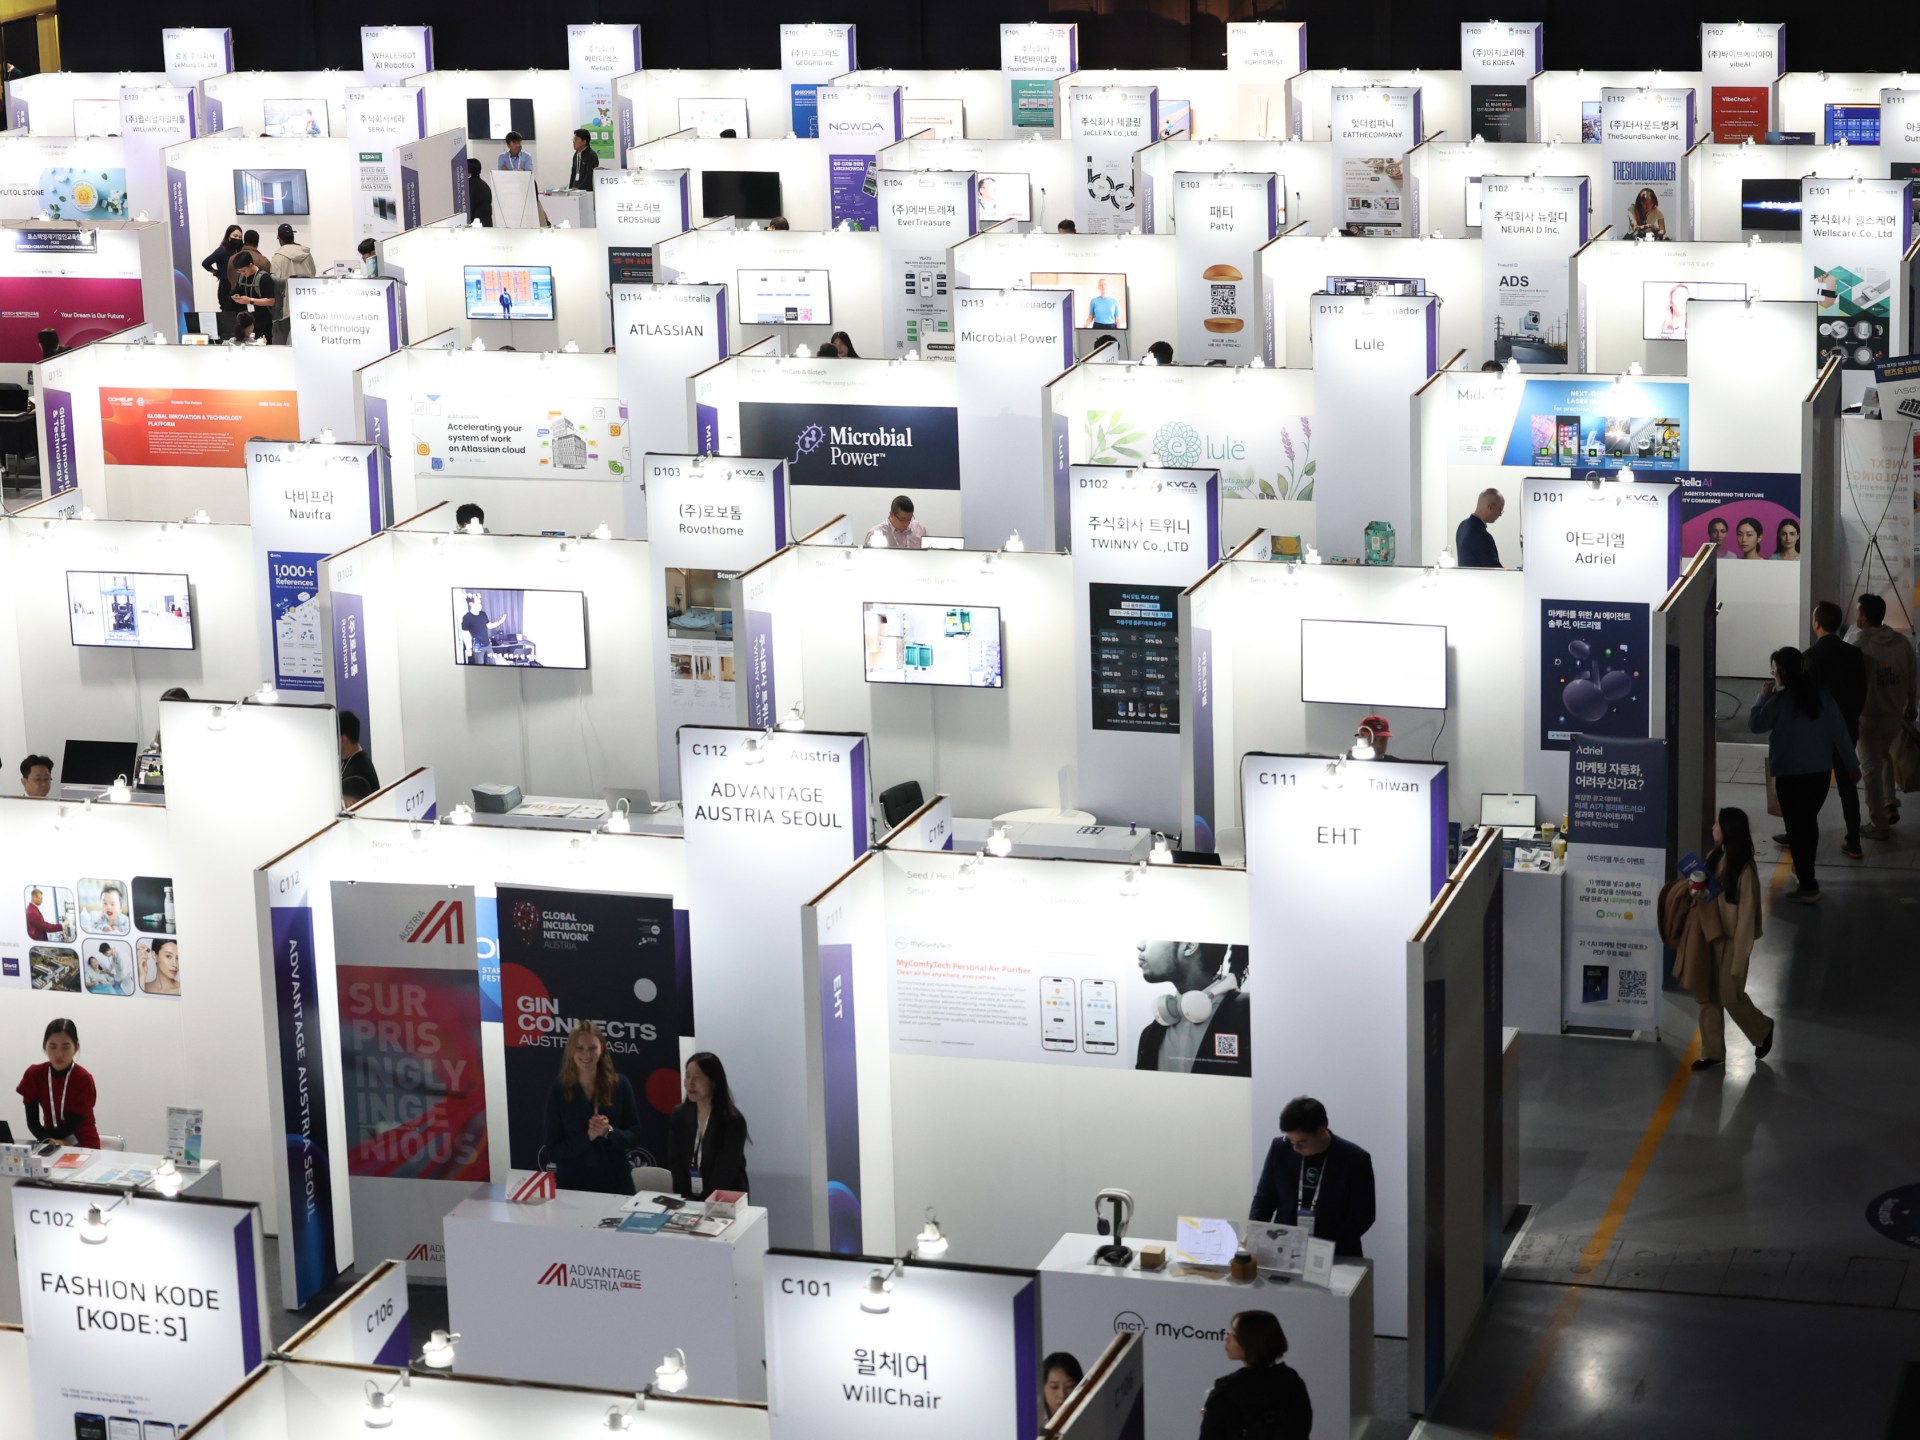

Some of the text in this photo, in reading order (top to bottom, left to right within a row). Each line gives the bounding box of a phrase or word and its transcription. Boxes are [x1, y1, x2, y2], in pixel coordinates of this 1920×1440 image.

[372, 52, 417, 60] WHALESBOT
[384, 61, 415, 69] Robotics
[1080, 117, 1142, 127] 주식회사 제클린
[1609, 120, 1679, 131] (주)더사운드벙커
[1342, 131, 1403, 139] EATTHECOMPANY
[1612, 160, 1676, 182] THESOUNDBUNKER
[1180, 180, 1200, 189] E103
[1488, 184, 1509, 193] E102
[22, 188, 45, 196] STONE
[1809, 187, 1830, 195] E101
[616, 202, 661, 213] 크로스허브
[1209, 205, 1234, 219] 패티
[618, 216, 661, 224] CROSSHUB
[897, 218, 951, 228] EverTreasure
[1494, 211, 1568, 223] 주식회사 뉴럴디
[1809, 214, 1851, 226] 주식회사
[1210, 222, 1235, 233] Patty
[1544, 226, 1561, 235] Inc.
[1499, 275, 1530, 287] ADS
[296, 288, 317, 296] D115
[620, 293, 643, 302] D114
[961, 300, 985, 308] D113
[1320, 306, 1345, 314] D112
[300, 311, 379, 322] Global Innovation
[310, 324, 371, 336] & Technology
[630, 324, 704, 337] ATLASSIAN
[321, 336, 362, 346] Platform
[960, 332, 1058, 344] Microbial Power
[1354, 338, 1385, 351] Lule
[206, 414, 243, 422] TECHNOLOGY
[448, 423, 523, 434] Accelerating your
[448, 434, 511, 443] system of work
[829, 426, 913, 448] Microbial
[460, 444, 501, 454] Atlassian
[502, 444, 526, 455] cloud
[255, 453, 281, 463] D104
[654, 466, 682, 477] D103
[735, 469, 765, 478] KVCA
[1080, 479, 1109, 489] D102
[1166, 480, 1198, 489] KVCA
[284, 490, 334, 505] 나비프라
[1533, 492, 1564, 503] D101
[1626, 494, 1658, 502] KVCA
[1684, 490, 1705, 498] AGENTS
[290, 508, 332, 521] Navifra
[679, 503, 743, 521] (주)로보톰
[679, 523, 744, 537] Rovothome
[1088, 516, 1190, 535] 주식회사 트위니
[1090, 538, 1189, 553] TWINNY Co.,LTD
[1566, 531, 1626, 549] 아드리엘
[1575, 552, 1617, 565] Adriel
[273, 564, 315, 579] 1,000+
[275, 578, 314, 587] References
[1548, 610, 1632, 621] 마케터를 위한 AI 에이전트
[1548, 620, 1602, 630] 솔루션, 아드리엘
[692, 743, 841, 764] C112 Austria
[1575, 745, 1604, 756] Adriel
[1575, 760, 1644, 778] 마케팅 자동화,
[1259, 772, 1420, 793] C111 Taiwan
[1575, 776, 1645, 791] 어려우신가요?
[710, 782, 824, 804] ADVANTAGE
[405, 790, 426, 813] C117
[694, 806, 843, 829] AUSTRIA SEOUL
[928, 821, 946, 844] C116
[1317, 826, 1362, 846] EHT
[279, 870, 301, 894] C112
[542, 910, 578, 922] GLOBAL
[398, 909, 426, 943] AUSTRIA
[542, 921, 595, 933] INCUBATOR
[543, 931, 590, 942] NETWORK
[544, 940, 578, 951] AUSTRIA
[896, 959, 952, 970] MyComfyTech
[952, 962, 987, 972] Personal
[1002, 966, 1032, 975] Purifier
[289, 940, 306, 1062] ADVANTAGE
[350, 982, 429, 1018] SUR
[833, 974, 843, 1019] EHT
[516, 996, 560, 1014] GIN
[517, 1014, 658, 1041] CONECTS
[352, 1020, 442, 1055] PRIS
[354, 1056, 468, 1093] INGLY
[298, 1066, 312, 1152] AUSTRIA
[357, 1094, 450, 1129] INGE
[304, 1156, 316, 1223] SEOUL
[29, 1208, 75, 1228] C102
[569, 1264, 642, 1282] ADVANTAGE
[570, 1276, 620, 1293] AUSTRIA
[781, 1278, 832, 1298] C101
[40, 1272, 220, 1311] FASHION KODE
[366, 1298, 394, 1333] C106
[76, 1305, 189, 1342] [KODE:S]
[852, 1348, 929, 1382] 윌체어
[842, 1383, 942, 1410] WillChair
